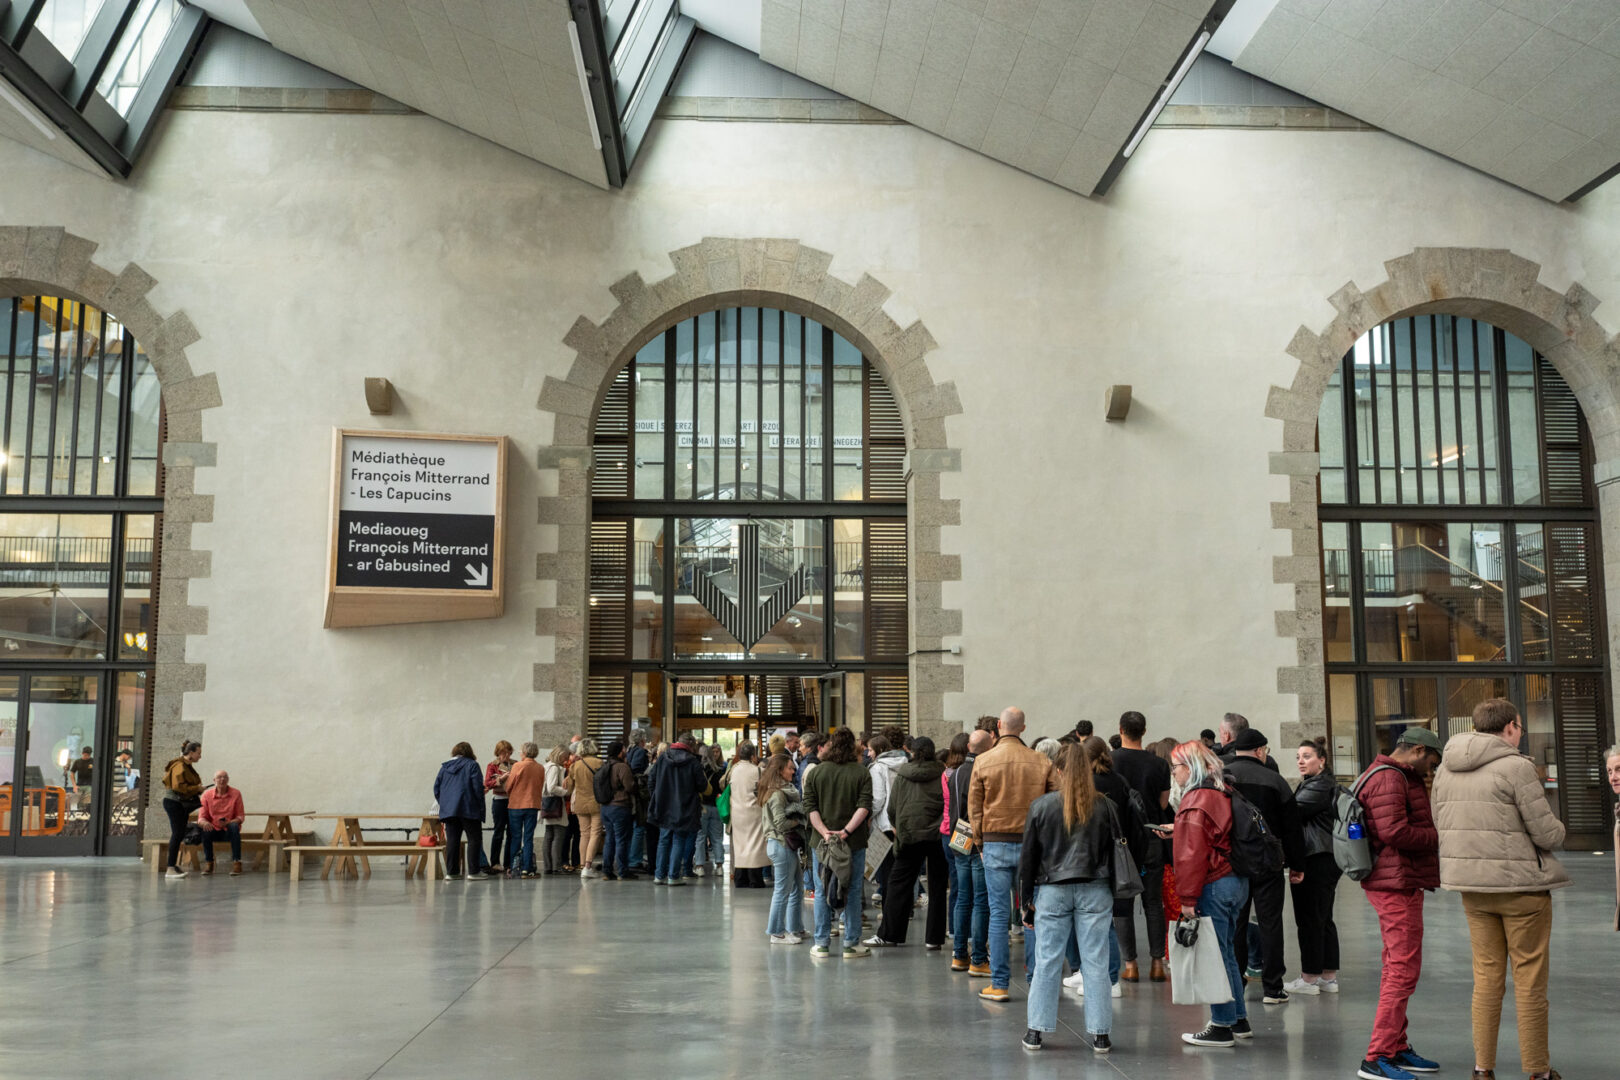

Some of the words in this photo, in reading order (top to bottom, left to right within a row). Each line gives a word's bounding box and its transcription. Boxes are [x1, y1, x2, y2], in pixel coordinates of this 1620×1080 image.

[681, 437, 709, 445] CINMA
[719, 437, 738, 446] INEM
[352, 450, 445, 468] Médiathèque
[351, 468, 412, 485] François
[415, 470, 490, 486] Mitterrand
[360, 486, 383, 499] Les
[386, 487, 452, 504] Capucins
[349, 521, 428, 540] Mediaoueg
[348, 539, 410, 557] François
[412, 541, 488, 556] Mitterrand
[356, 561, 373, 571] ar
[375, 558, 451, 573] Gabusined
